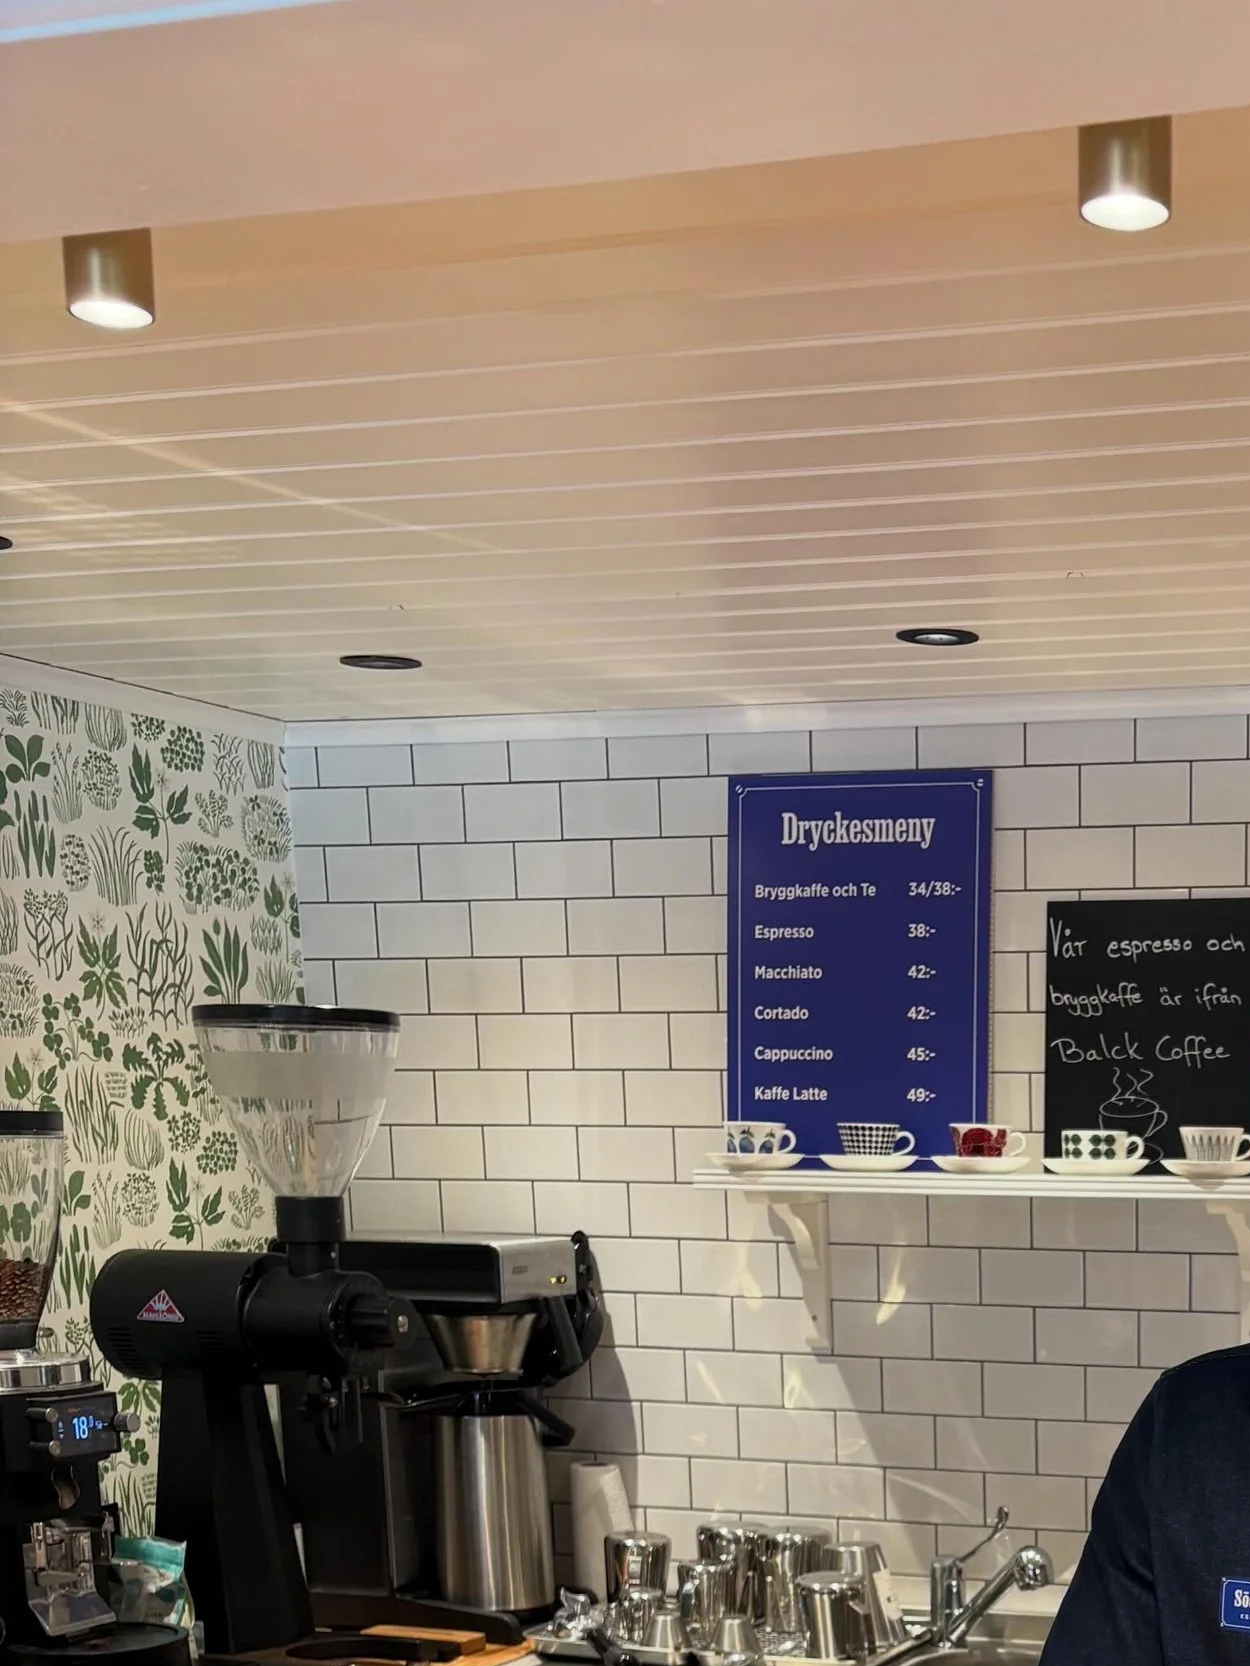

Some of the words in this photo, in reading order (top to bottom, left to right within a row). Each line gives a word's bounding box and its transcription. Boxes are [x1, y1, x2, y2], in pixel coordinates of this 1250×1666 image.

[781, 811, 936, 851] Dryckesmeny
[754, 883, 829, 900] Bryggkaffe
[832, 883, 857, 897] och
[861, 883, 876, 897] Te
[908, 881, 962, 898] 34/38:-
[754, 924, 814, 941] Espresso
[908, 923, 936, 938] 38:-
[1050, 917, 1087, 958] Vår
[1107, 938, 1193, 963] espresso
[1206, 933, 1246, 952] och
[754, 965, 823, 980] Macchiato
[907, 964, 936, 979] 42:-
[1049, 981, 1144, 1018] bryggkaffe
[1159, 986, 1183, 1006] är
[1194, 982, 1242, 1011] ifrån
[754, 1005, 809, 1020] Cortado
[906, 1006, 936, 1020] 42:-
[754, 1046, 834, 1062] Cappuccino
[906, 1047, 936, 1061] 45:-
[1050, 1032, 1144, 1064] Balck
[1155, 1035, 1231, 1069] Coffee
[754, 1086, 790, 1101] Kaffe
[793, 1086, 828, 1101] Latte
[906, 1088, 936, 1102] 49:-
